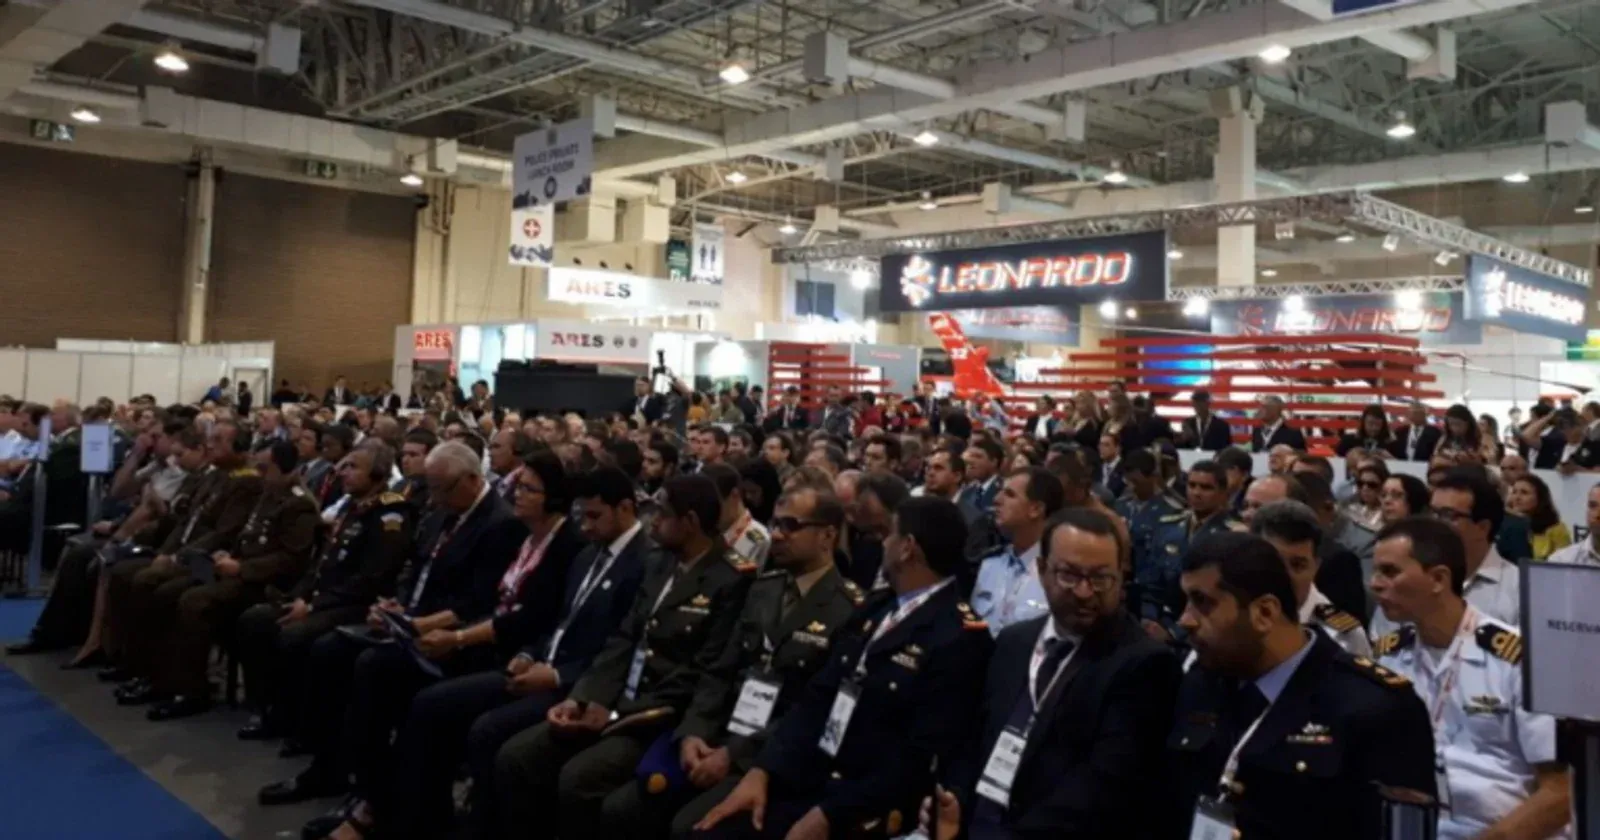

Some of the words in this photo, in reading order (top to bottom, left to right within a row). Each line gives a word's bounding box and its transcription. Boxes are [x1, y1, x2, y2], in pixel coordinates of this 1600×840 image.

[937, 252, 1133, 293] LEONARDO
[566, 278, 632, 299] ARES
[414, 330, 453, 350] ARES
[551, 331, 605, 348] ARES
